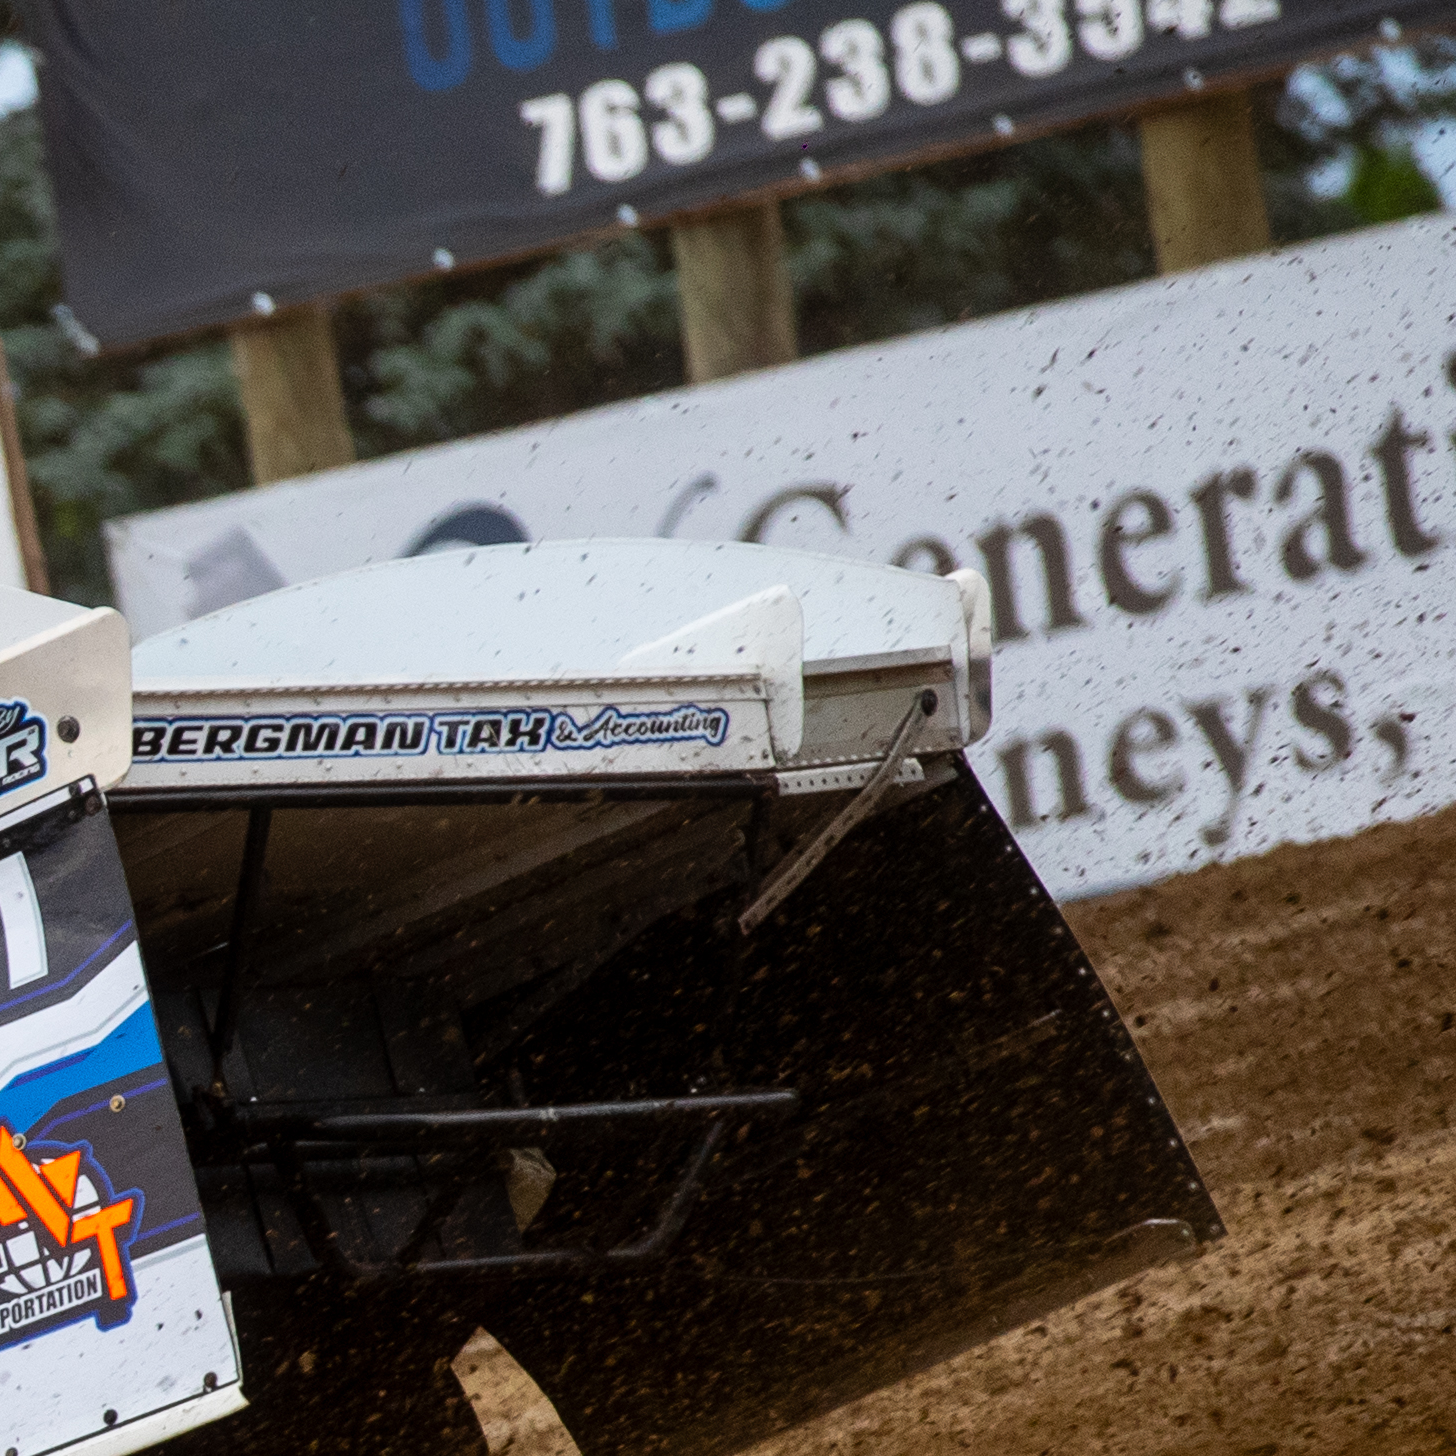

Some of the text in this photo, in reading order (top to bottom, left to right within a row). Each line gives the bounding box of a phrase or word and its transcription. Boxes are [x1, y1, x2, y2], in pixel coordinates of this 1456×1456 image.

[518, 0, 1281, 195] 763-238-35
[133, 705, 725, 757] BERGMAN TAX & Accounting
